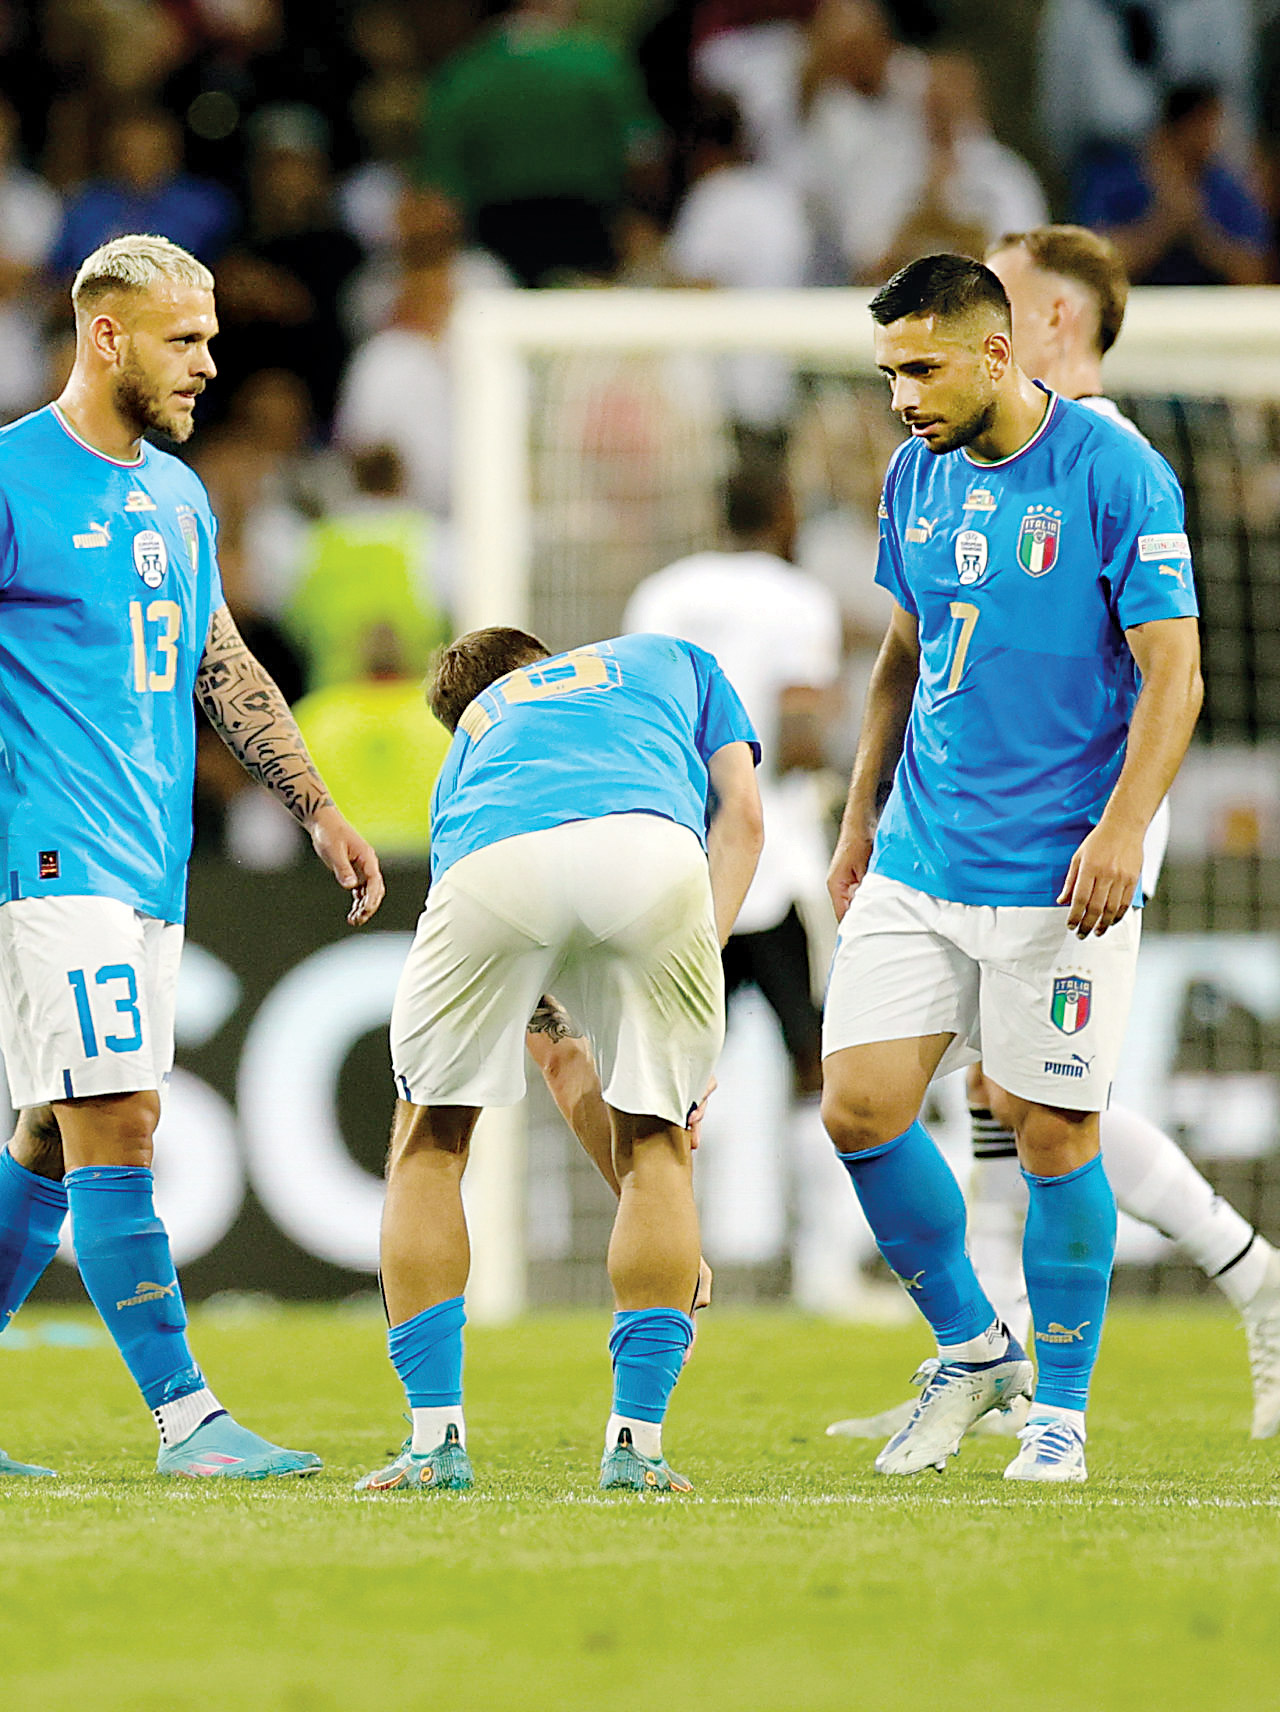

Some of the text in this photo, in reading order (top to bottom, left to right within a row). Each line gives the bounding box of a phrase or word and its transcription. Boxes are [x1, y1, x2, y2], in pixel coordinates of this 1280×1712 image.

[1024, 519, 1057, 532] ITALIA
[129, 600, 182, 693] 13
[949, 601, 980, 692] 7
[67, 963, 143, 1058] 13
[1055, 980, 1090, 991] ITALIA
[1044, 1061, 1084, 1078] PUMA
